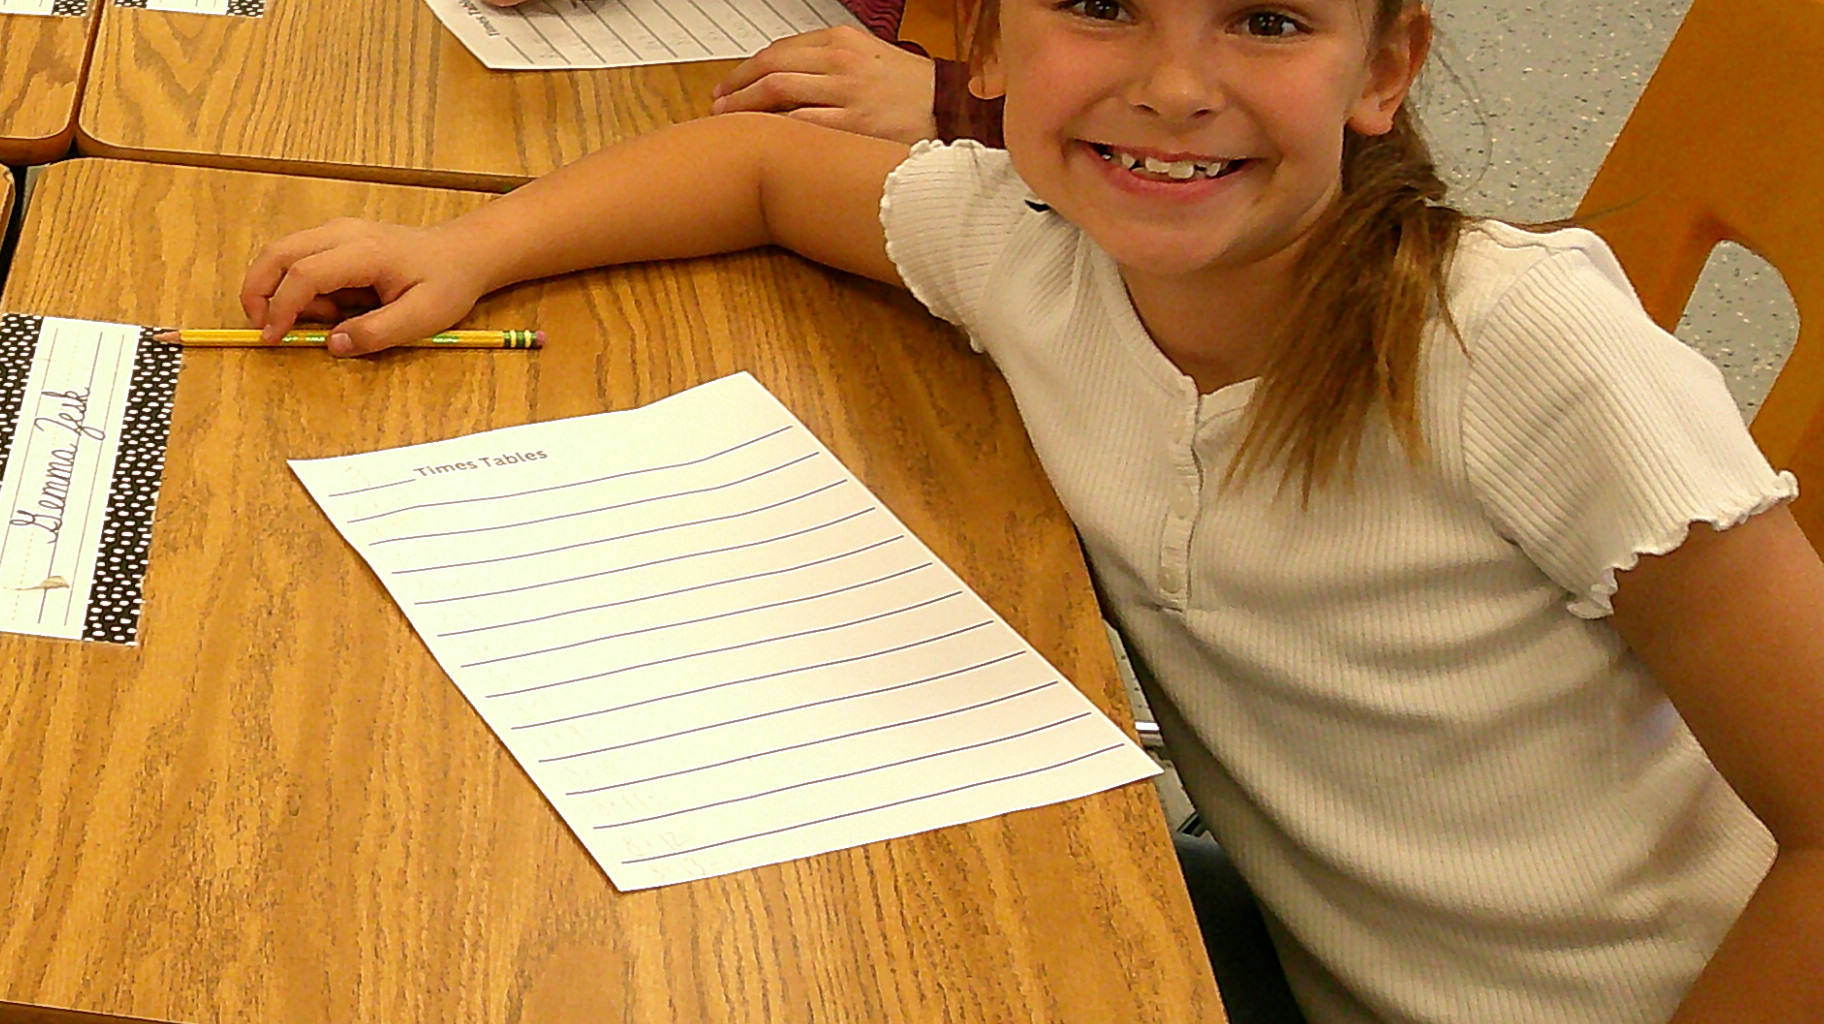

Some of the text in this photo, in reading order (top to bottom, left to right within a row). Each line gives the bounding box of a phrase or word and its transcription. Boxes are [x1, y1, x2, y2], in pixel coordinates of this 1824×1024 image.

[9, 442, 79, 544] Gemma
[412, 449, 549, 477] Times Tables
